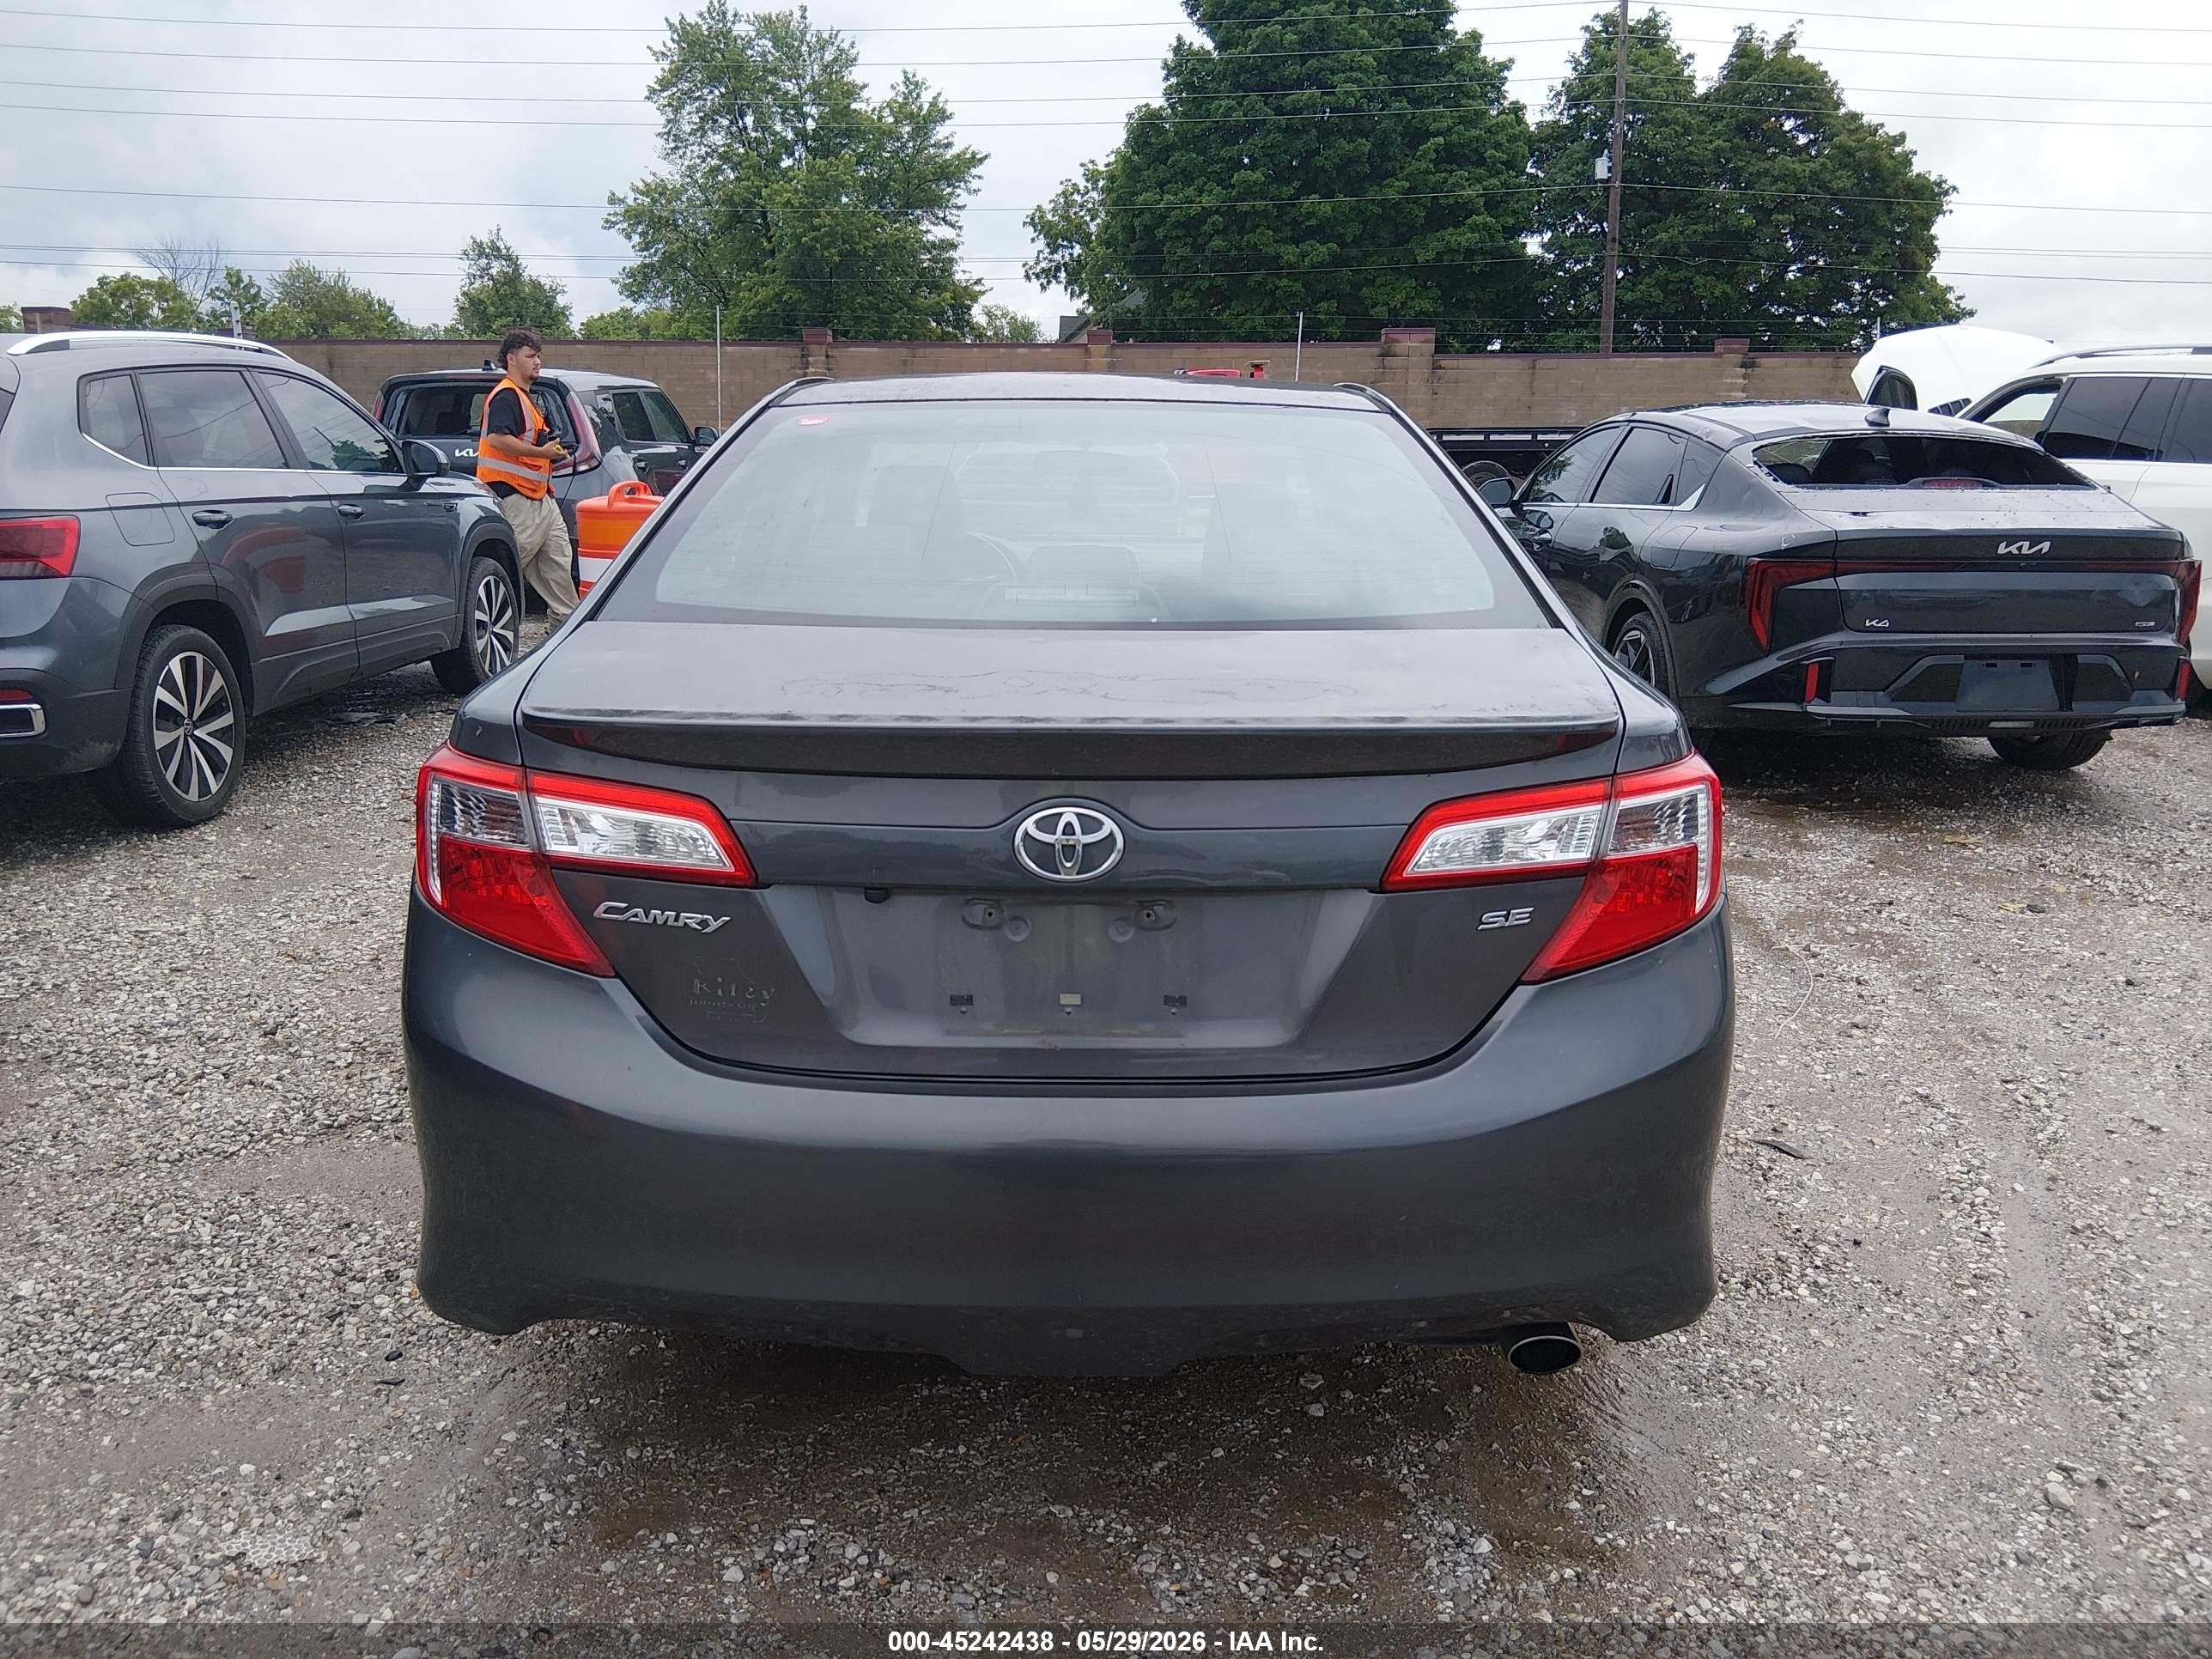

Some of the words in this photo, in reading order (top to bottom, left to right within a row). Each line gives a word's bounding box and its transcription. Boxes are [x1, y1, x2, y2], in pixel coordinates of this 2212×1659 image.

[1996, 541, 2051, 555] KIA
[1865, 618, 1890, 628] K4
[1477, 907, 1535, 931] SE
